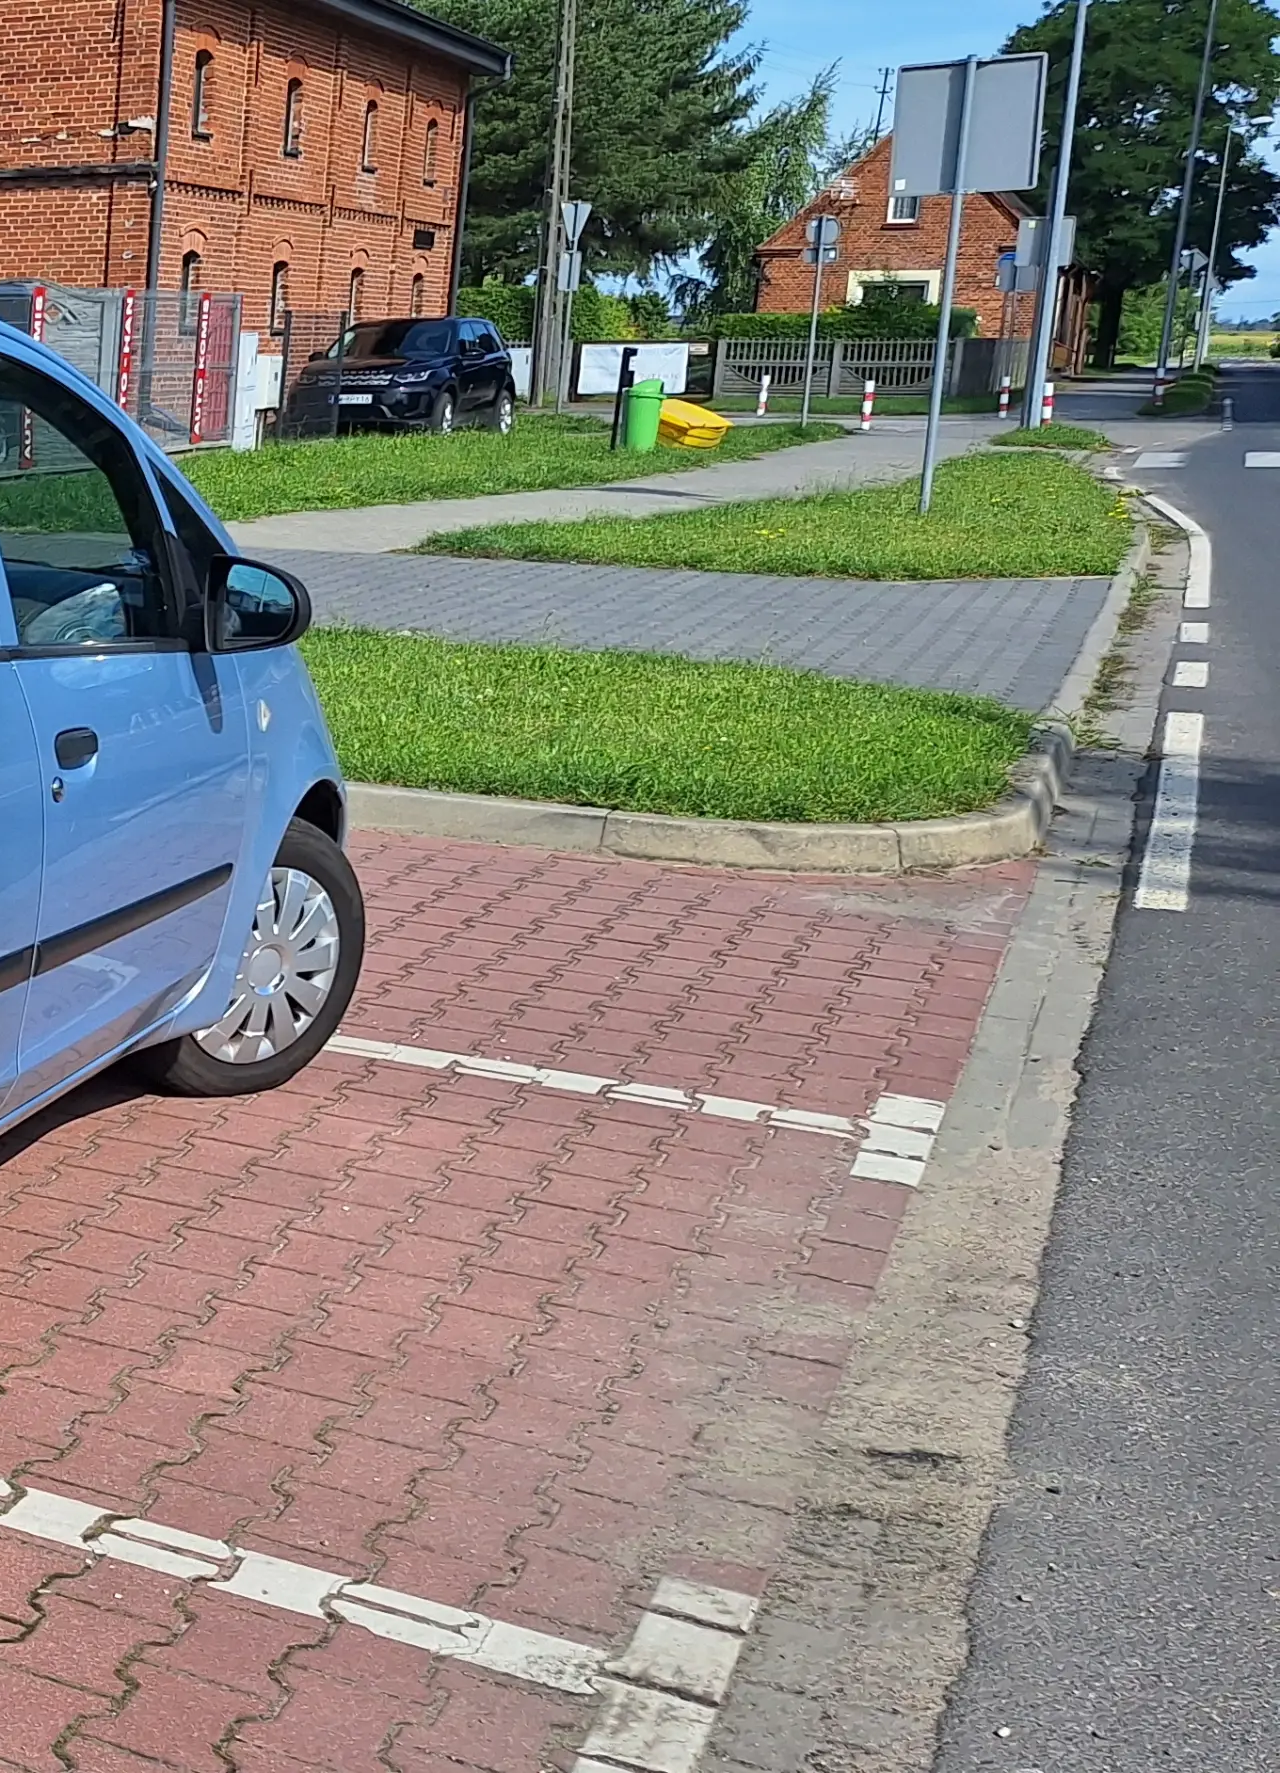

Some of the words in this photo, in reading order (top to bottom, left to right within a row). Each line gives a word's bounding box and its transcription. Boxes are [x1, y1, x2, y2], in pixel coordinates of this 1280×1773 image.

[33, 295, 43, 341] MIS
[193, 378, 203, 435] AUTO
[198, 299, 209, 369] KOMIS
